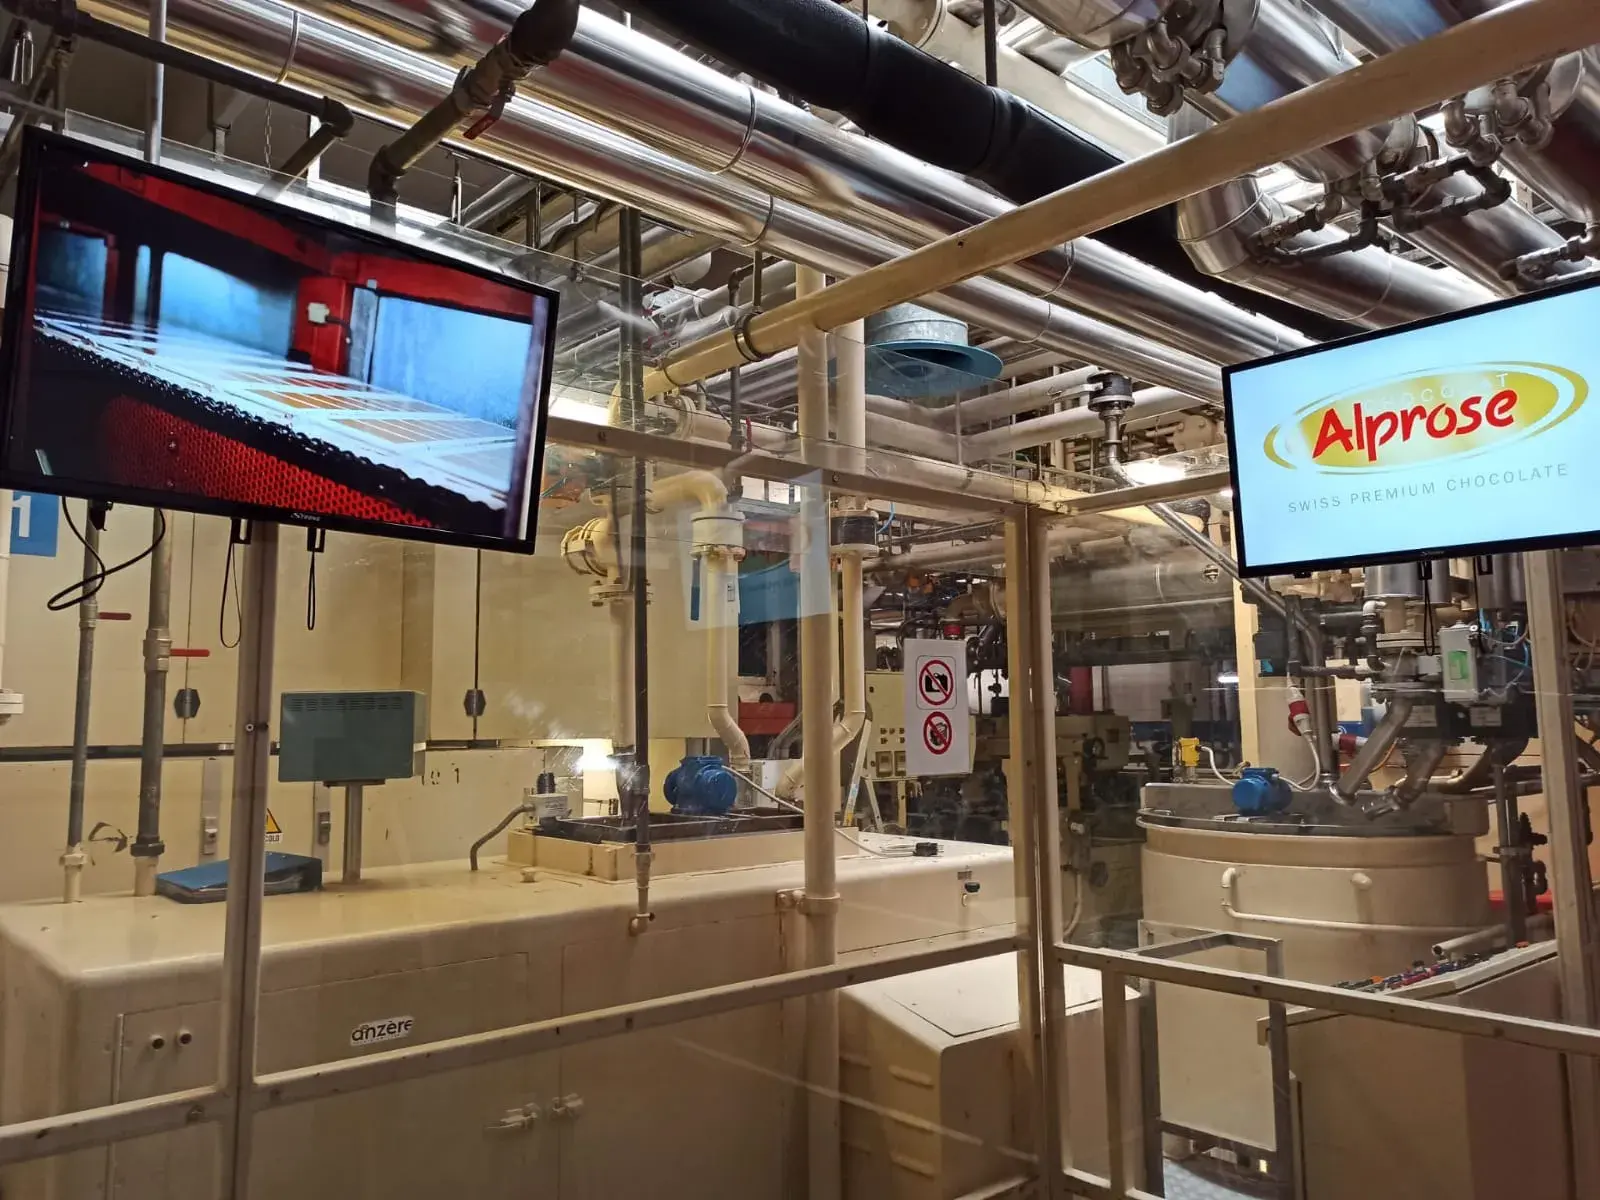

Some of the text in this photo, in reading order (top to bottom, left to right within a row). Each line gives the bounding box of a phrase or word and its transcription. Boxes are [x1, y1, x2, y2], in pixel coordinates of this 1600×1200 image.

[1312, 389, 1518, 461] Alprose
[1288, 463, 1568, 513] SWISS PREMIUM CHOCOLATE
[12, 495, 31, 538] 1
